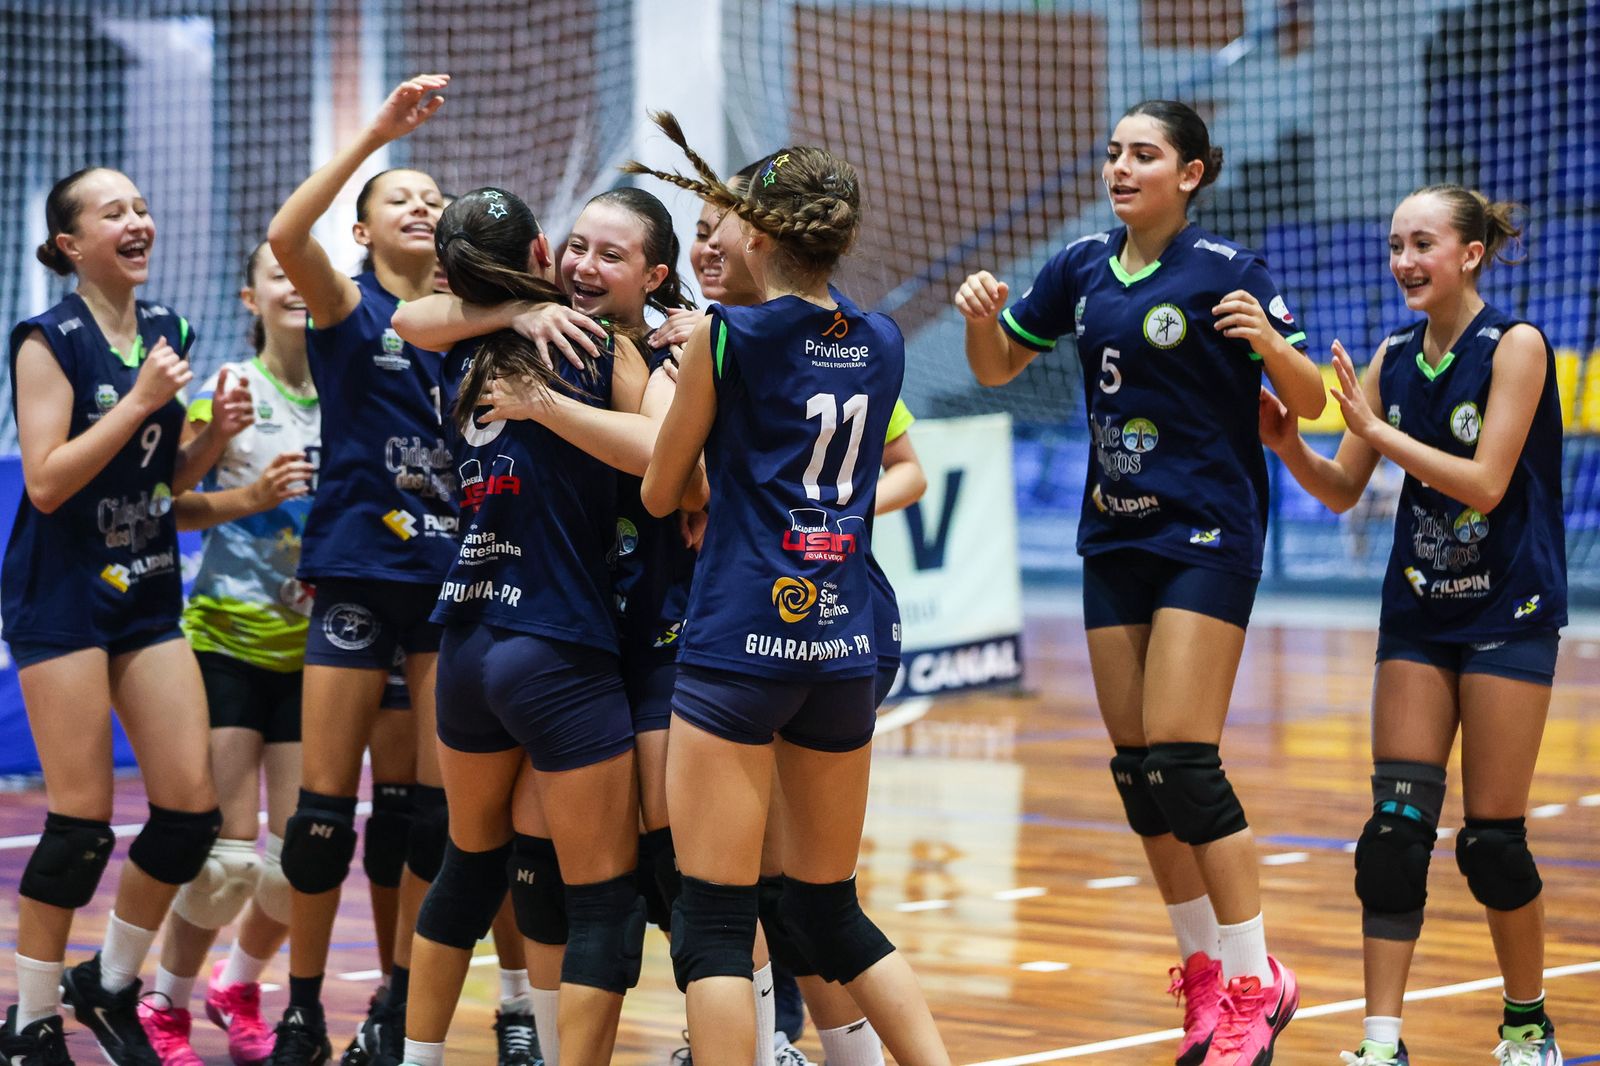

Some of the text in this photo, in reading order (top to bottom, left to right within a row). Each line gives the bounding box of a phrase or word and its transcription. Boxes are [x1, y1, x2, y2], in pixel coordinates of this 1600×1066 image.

[805, 340, 869, 362] Privilege
[811, 360, 830, 368] PILATES
[834, 361, 867, 369] FISIOTERAPIA
[1099, 347, 1122, 395] 5
[140, 423, 162, 468] 9
[802, 393, 869, 505] 11
[793, 524, 826, 534] ACADEMIA
[1430, 574, 1491, 593] FILIPIN
